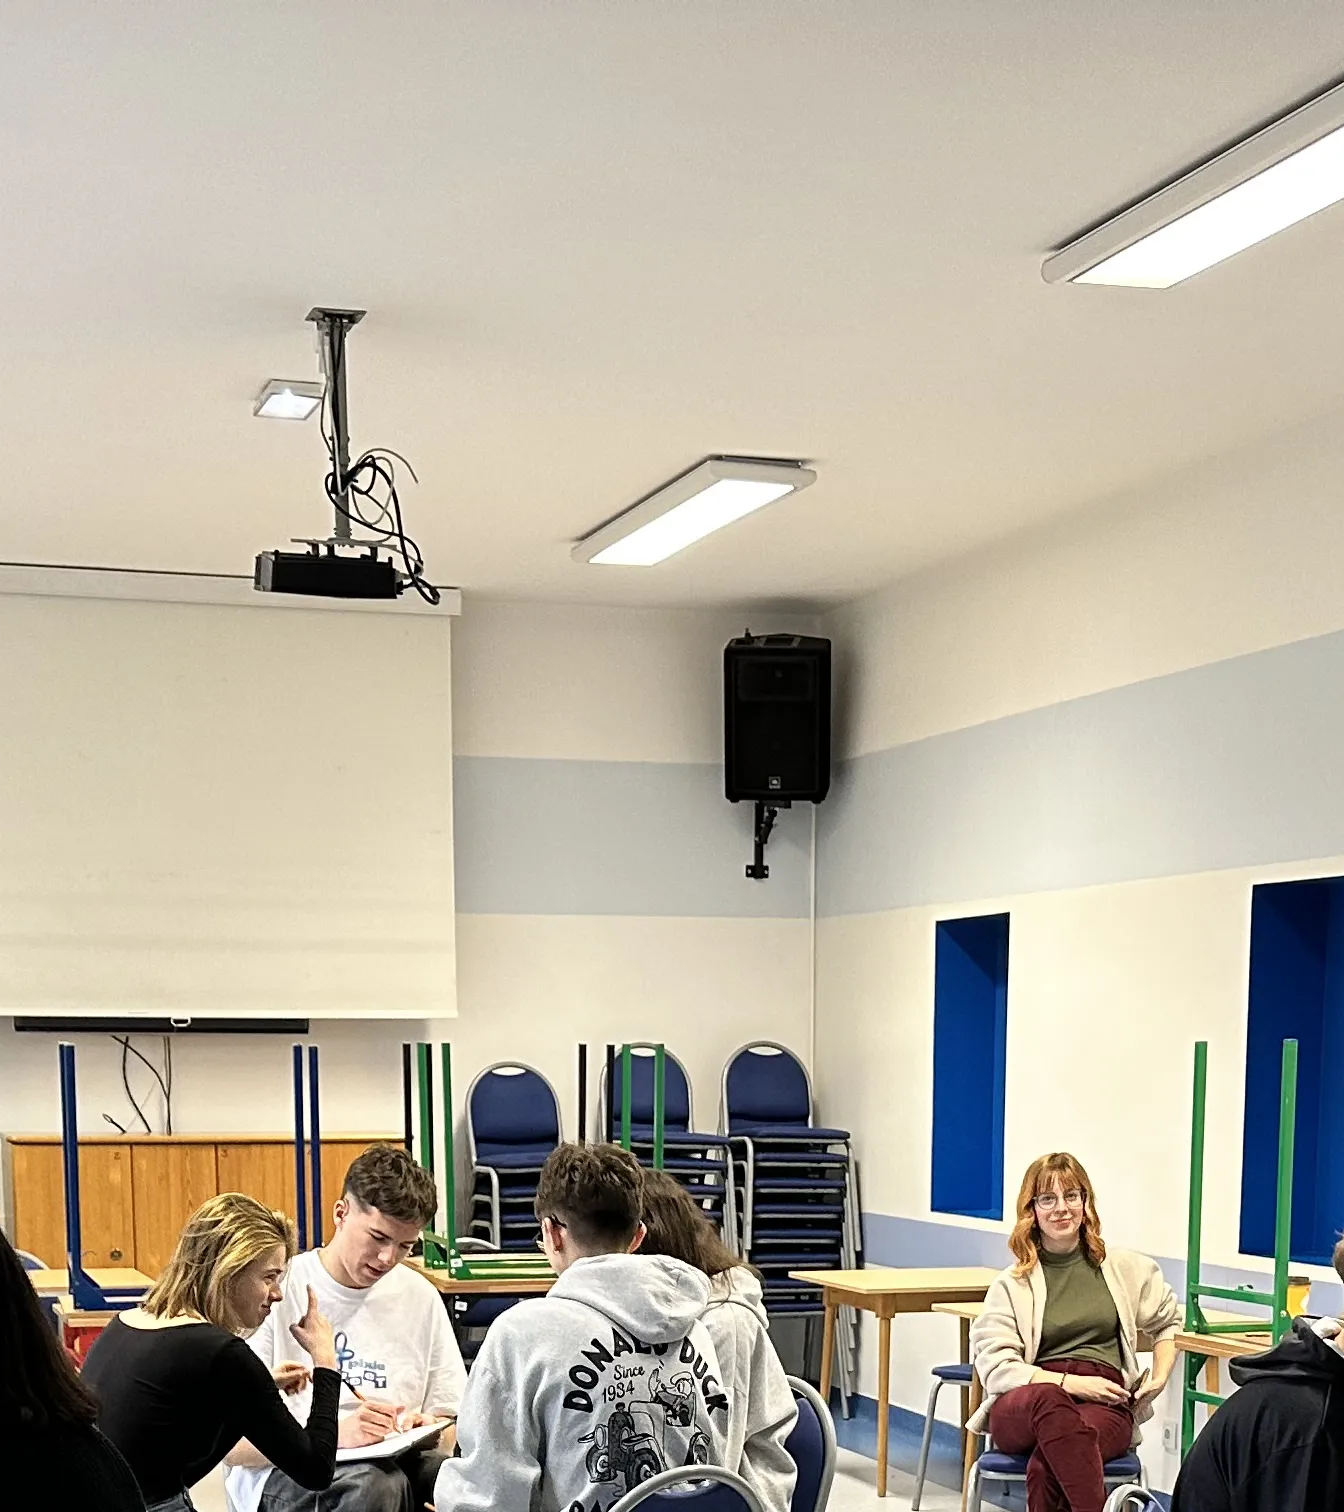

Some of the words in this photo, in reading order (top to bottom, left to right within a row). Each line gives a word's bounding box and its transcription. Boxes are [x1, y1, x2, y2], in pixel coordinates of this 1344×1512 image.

[614, 1364, 645, 1381] Since
[679, 1336, 729, 1416] DUCK
[602, 1380, 635, 1403] 1934
